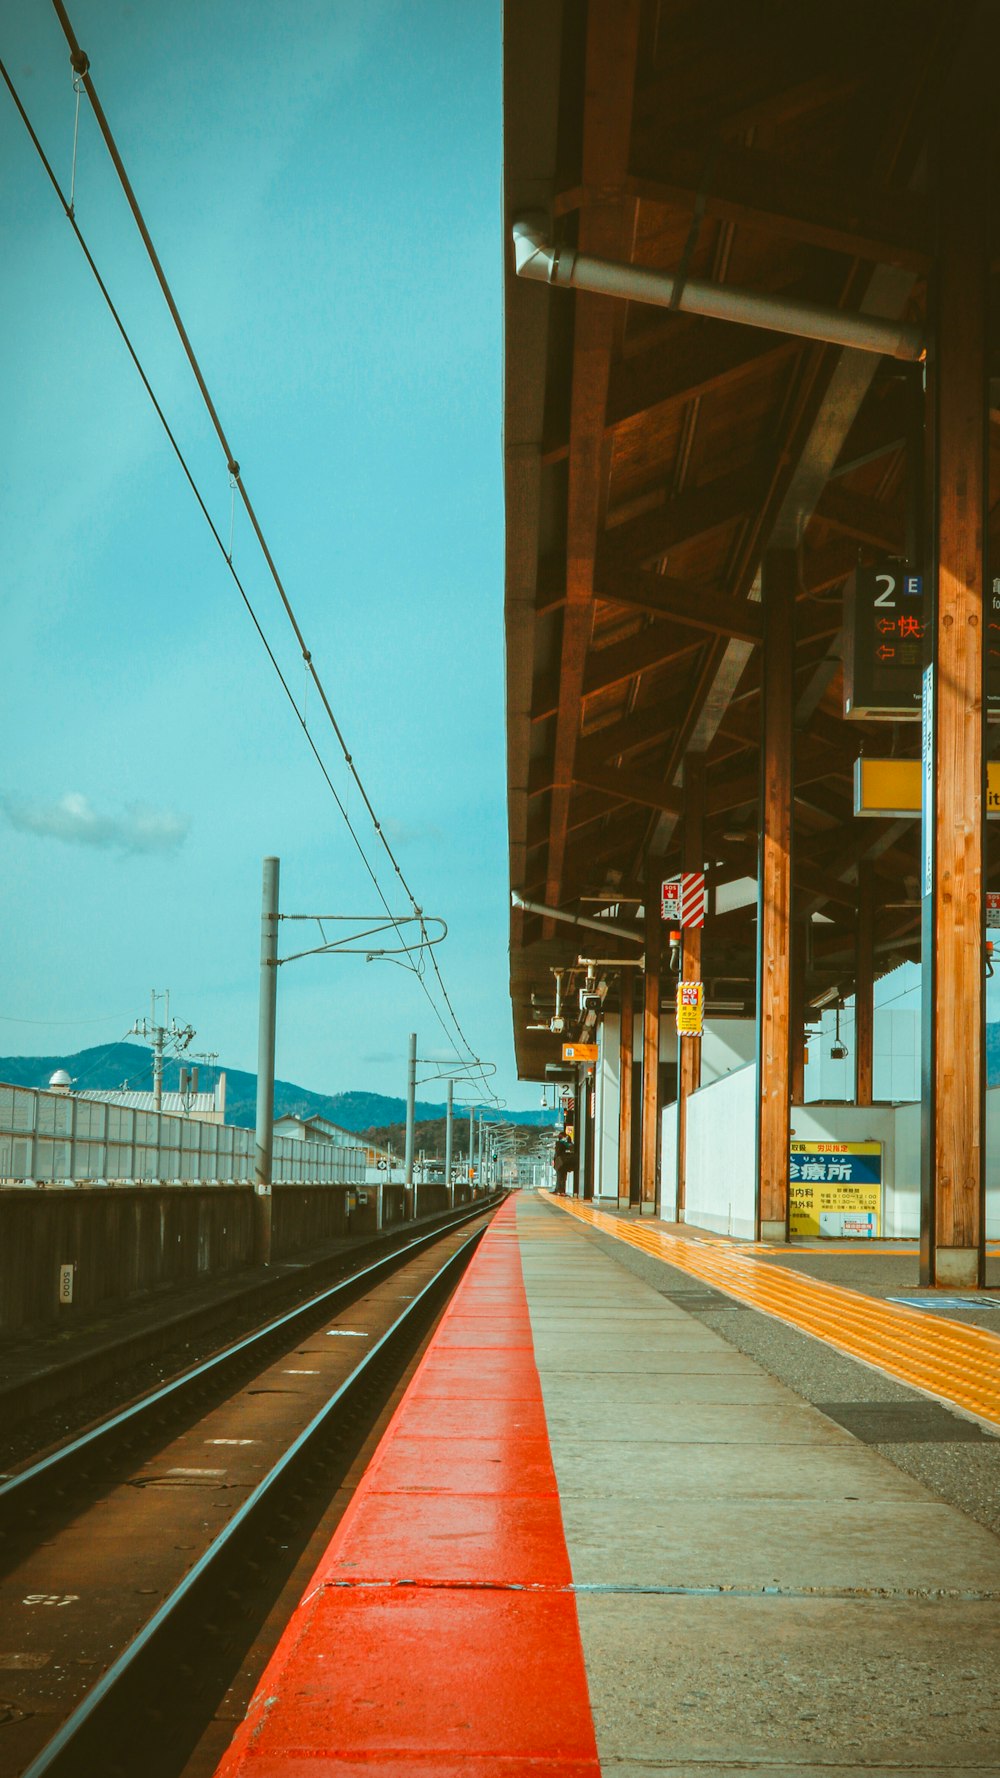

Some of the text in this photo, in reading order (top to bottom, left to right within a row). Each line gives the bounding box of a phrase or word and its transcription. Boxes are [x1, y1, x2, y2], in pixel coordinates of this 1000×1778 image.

[874, 575, 918, 607] 2 E
[898, 615, 926, 638] 快
[562, 1084, 570, 1096] 2
